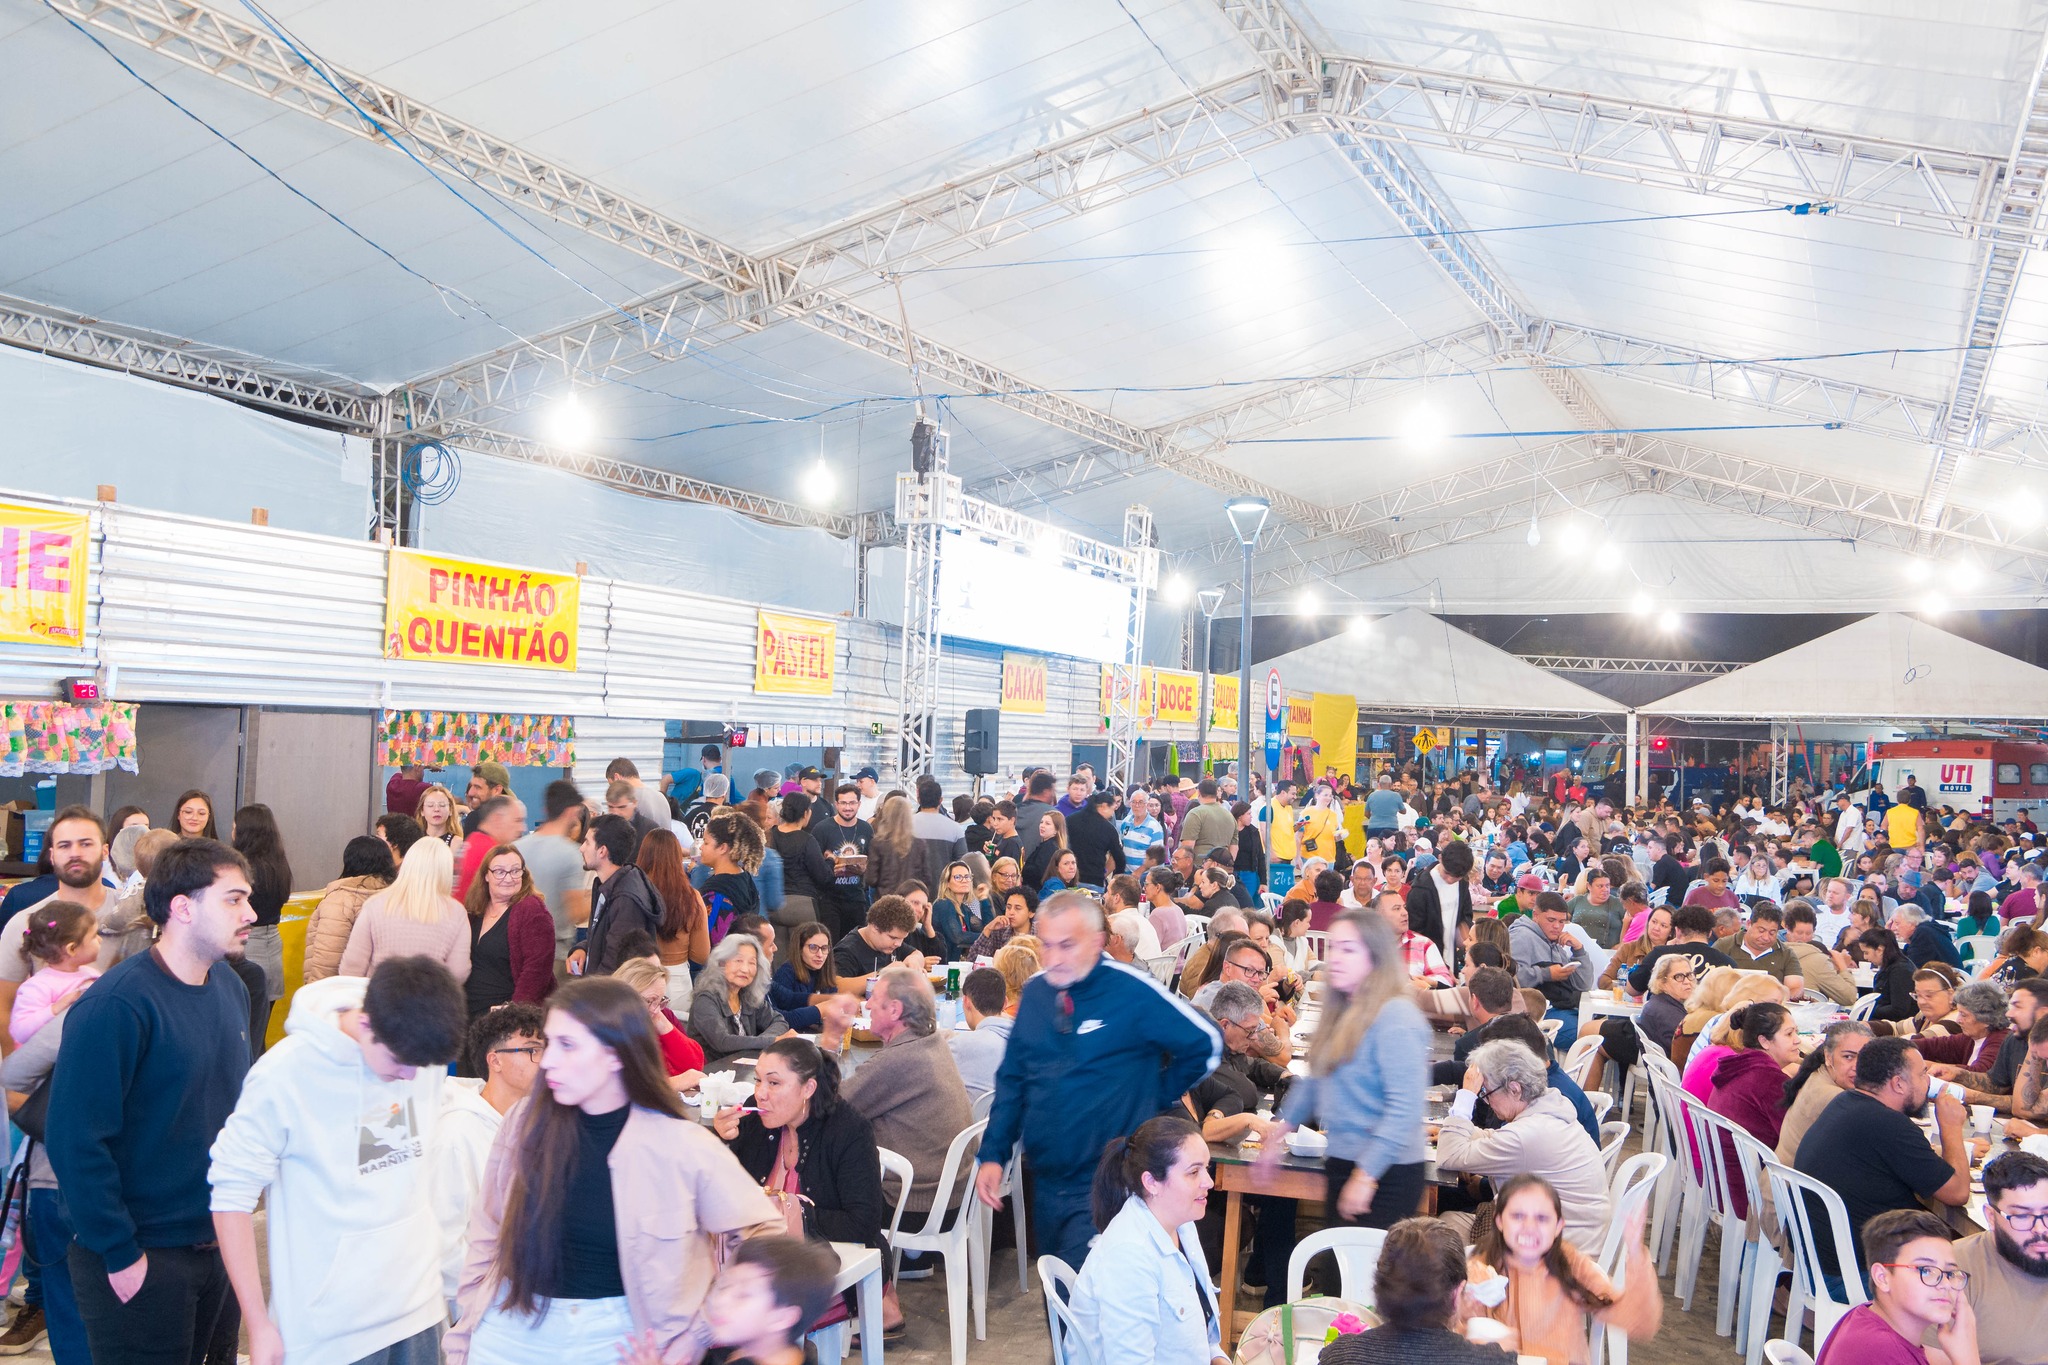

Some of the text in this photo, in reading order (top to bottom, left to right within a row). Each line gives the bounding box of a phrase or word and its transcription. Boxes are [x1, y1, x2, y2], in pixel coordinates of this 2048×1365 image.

[429, 567, 556, 617] PINHÃO
[408, 616, 569, 664] QUENTÃO
[762, 629, 829, 679] PASTEL
[1004, 663, 1044, 702] CAIXA
[1160, 683, 1193, 712] DOCE
[1215, 684, 1237, 711] CALDOS
[1271, 678, 1278, 710] E
[1288, 704, 1312, 725] TAINHA
[1940, 764, 1973, 784] UTI
